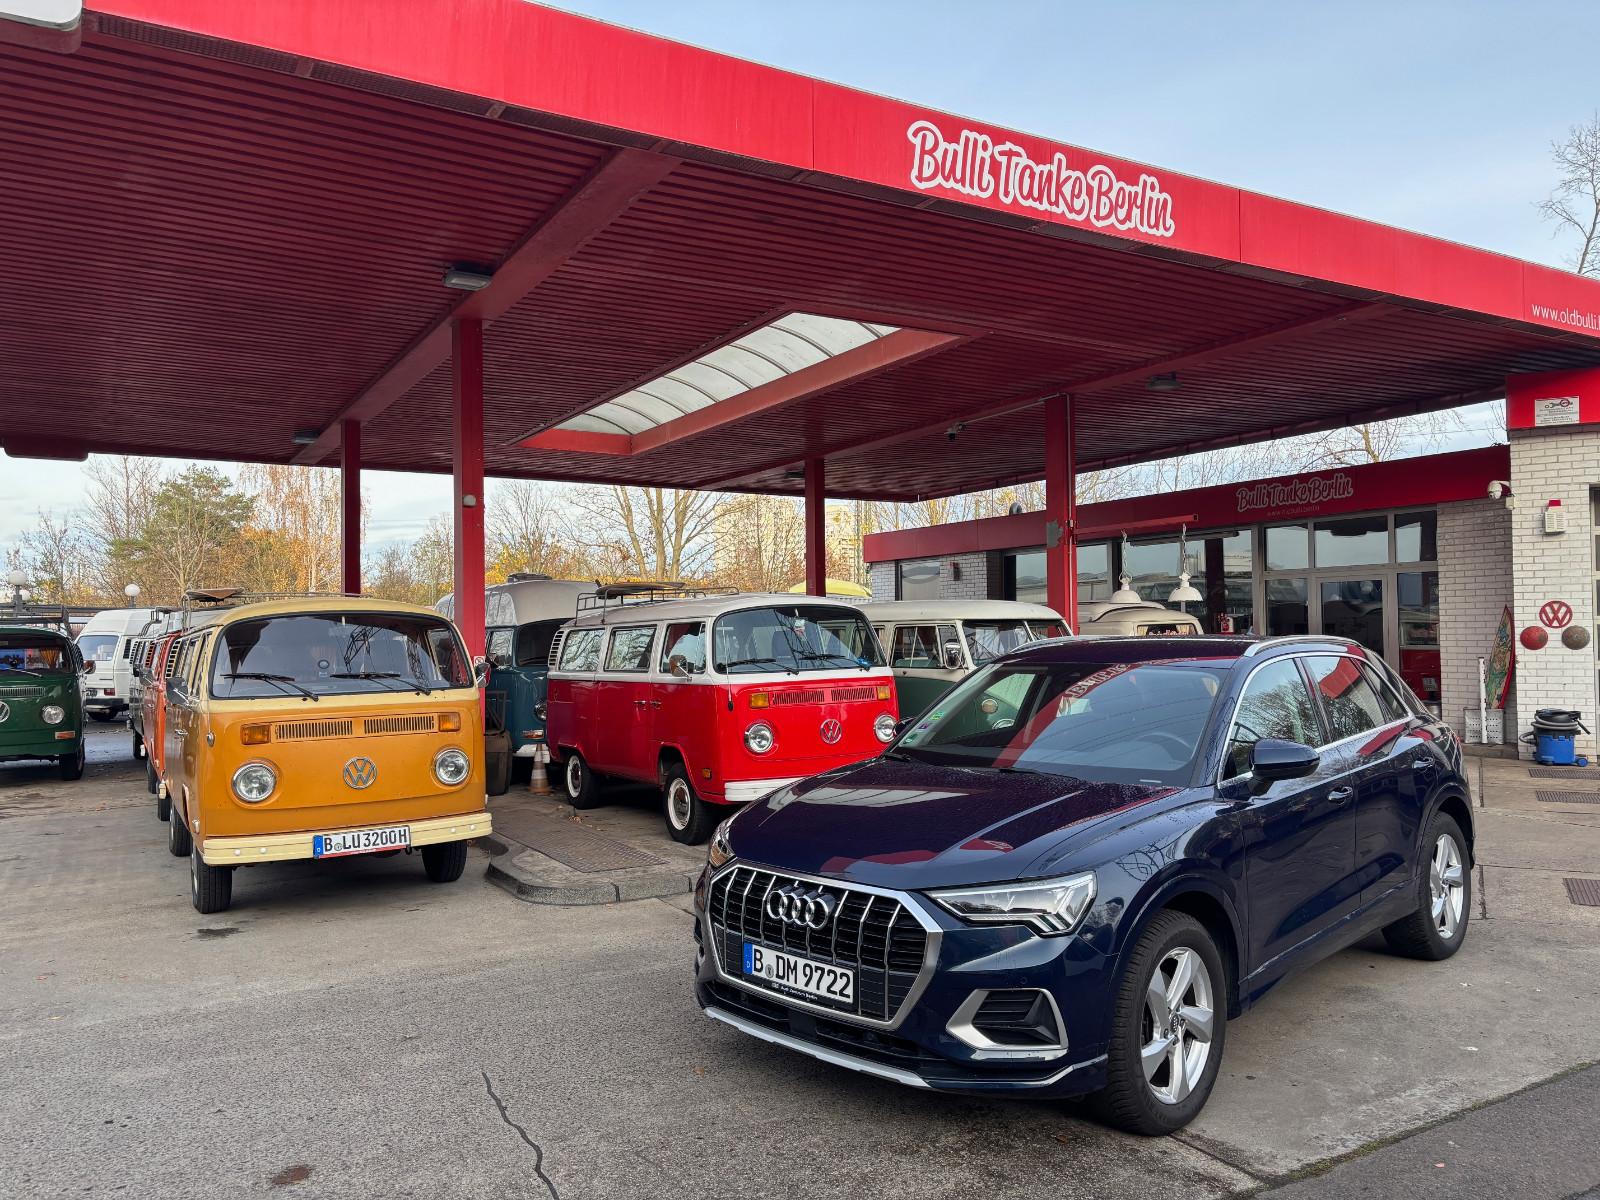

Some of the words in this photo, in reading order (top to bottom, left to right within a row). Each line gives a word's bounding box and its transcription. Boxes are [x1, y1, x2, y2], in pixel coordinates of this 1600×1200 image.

[907, 121, 994, 198] Bulli
[994, 141, 1088, 221] Tanke
[1087, 165, 1175, 237] Berlin
[1531, 303, 1600, 331] www.oldbulli.
[1236, 484, 1269, 512] Bulli
[1268, 479, 1309, 507] Tanke
[1308, 473, 1354, 503] Berlin
[343, 756, 377, 790] VW
[324, 837, 333, 852] B
[753, 948, 764, 973] B
[775, 954, 798, 985] DM
[802, 962, 851, 999] 9722
